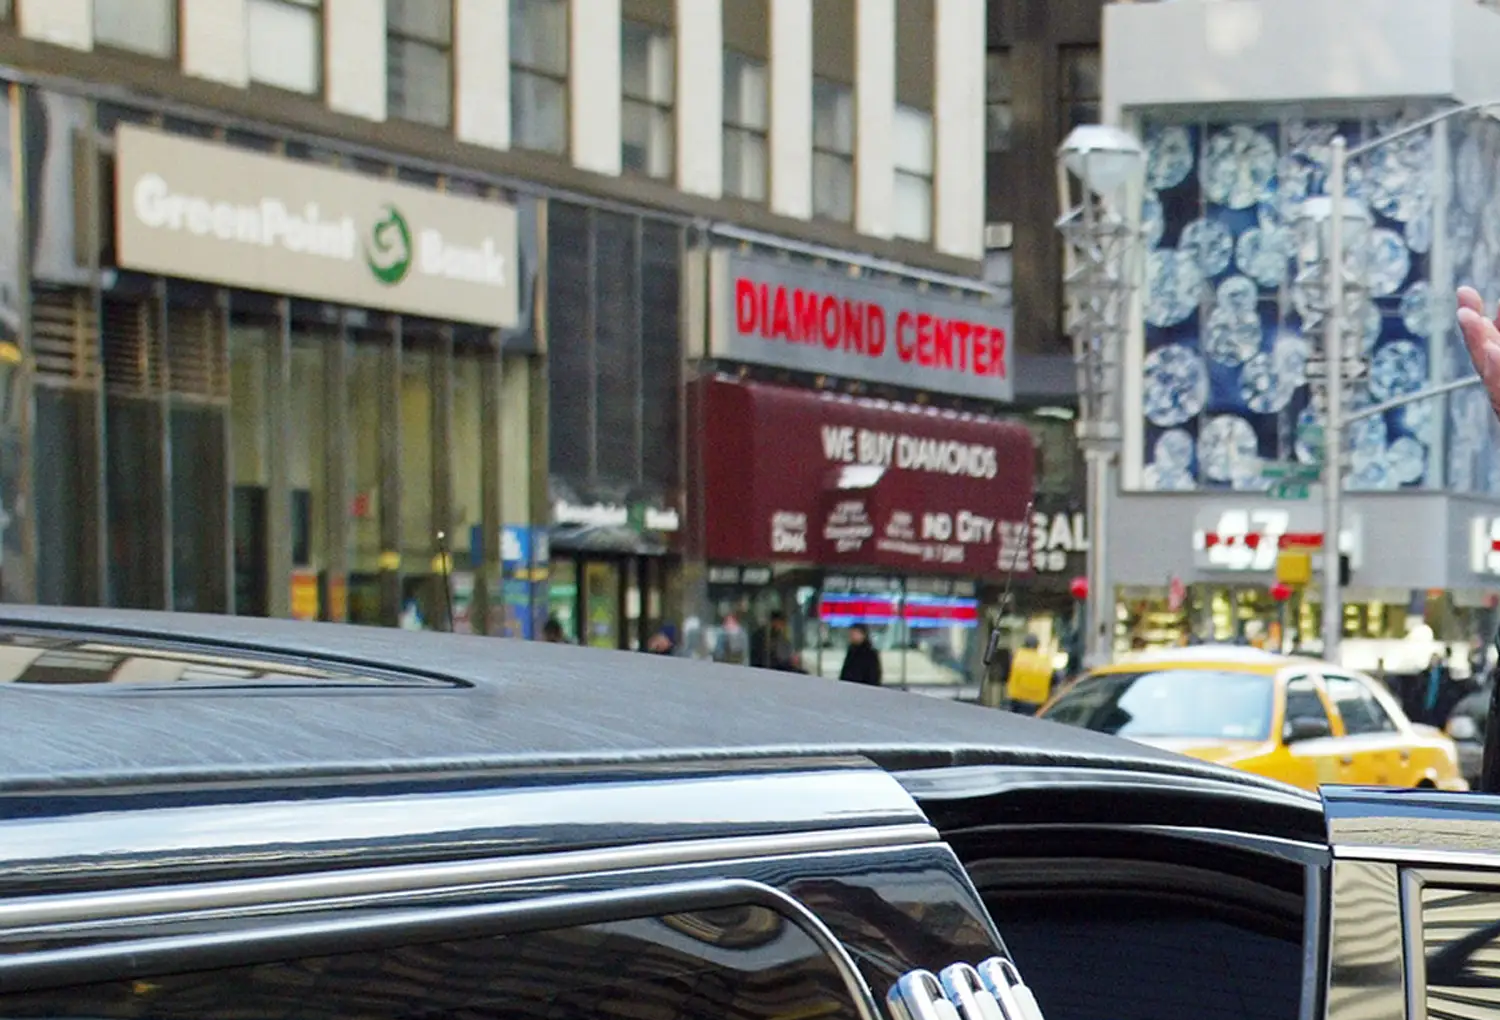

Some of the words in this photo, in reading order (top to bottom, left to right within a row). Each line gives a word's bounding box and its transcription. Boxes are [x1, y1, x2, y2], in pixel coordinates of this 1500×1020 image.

[133, 172, 356, 260] GreenPoint
[418, 227, 507, 287] Bank
[734, 277, 887, 358] DIAMOND
[894, 309, 1007, 380] CENTER
[821, 425, 856, 463] WE
[857, 429, 896, 466] BUY
[896, 434, 998, 480] DIAMONDS
